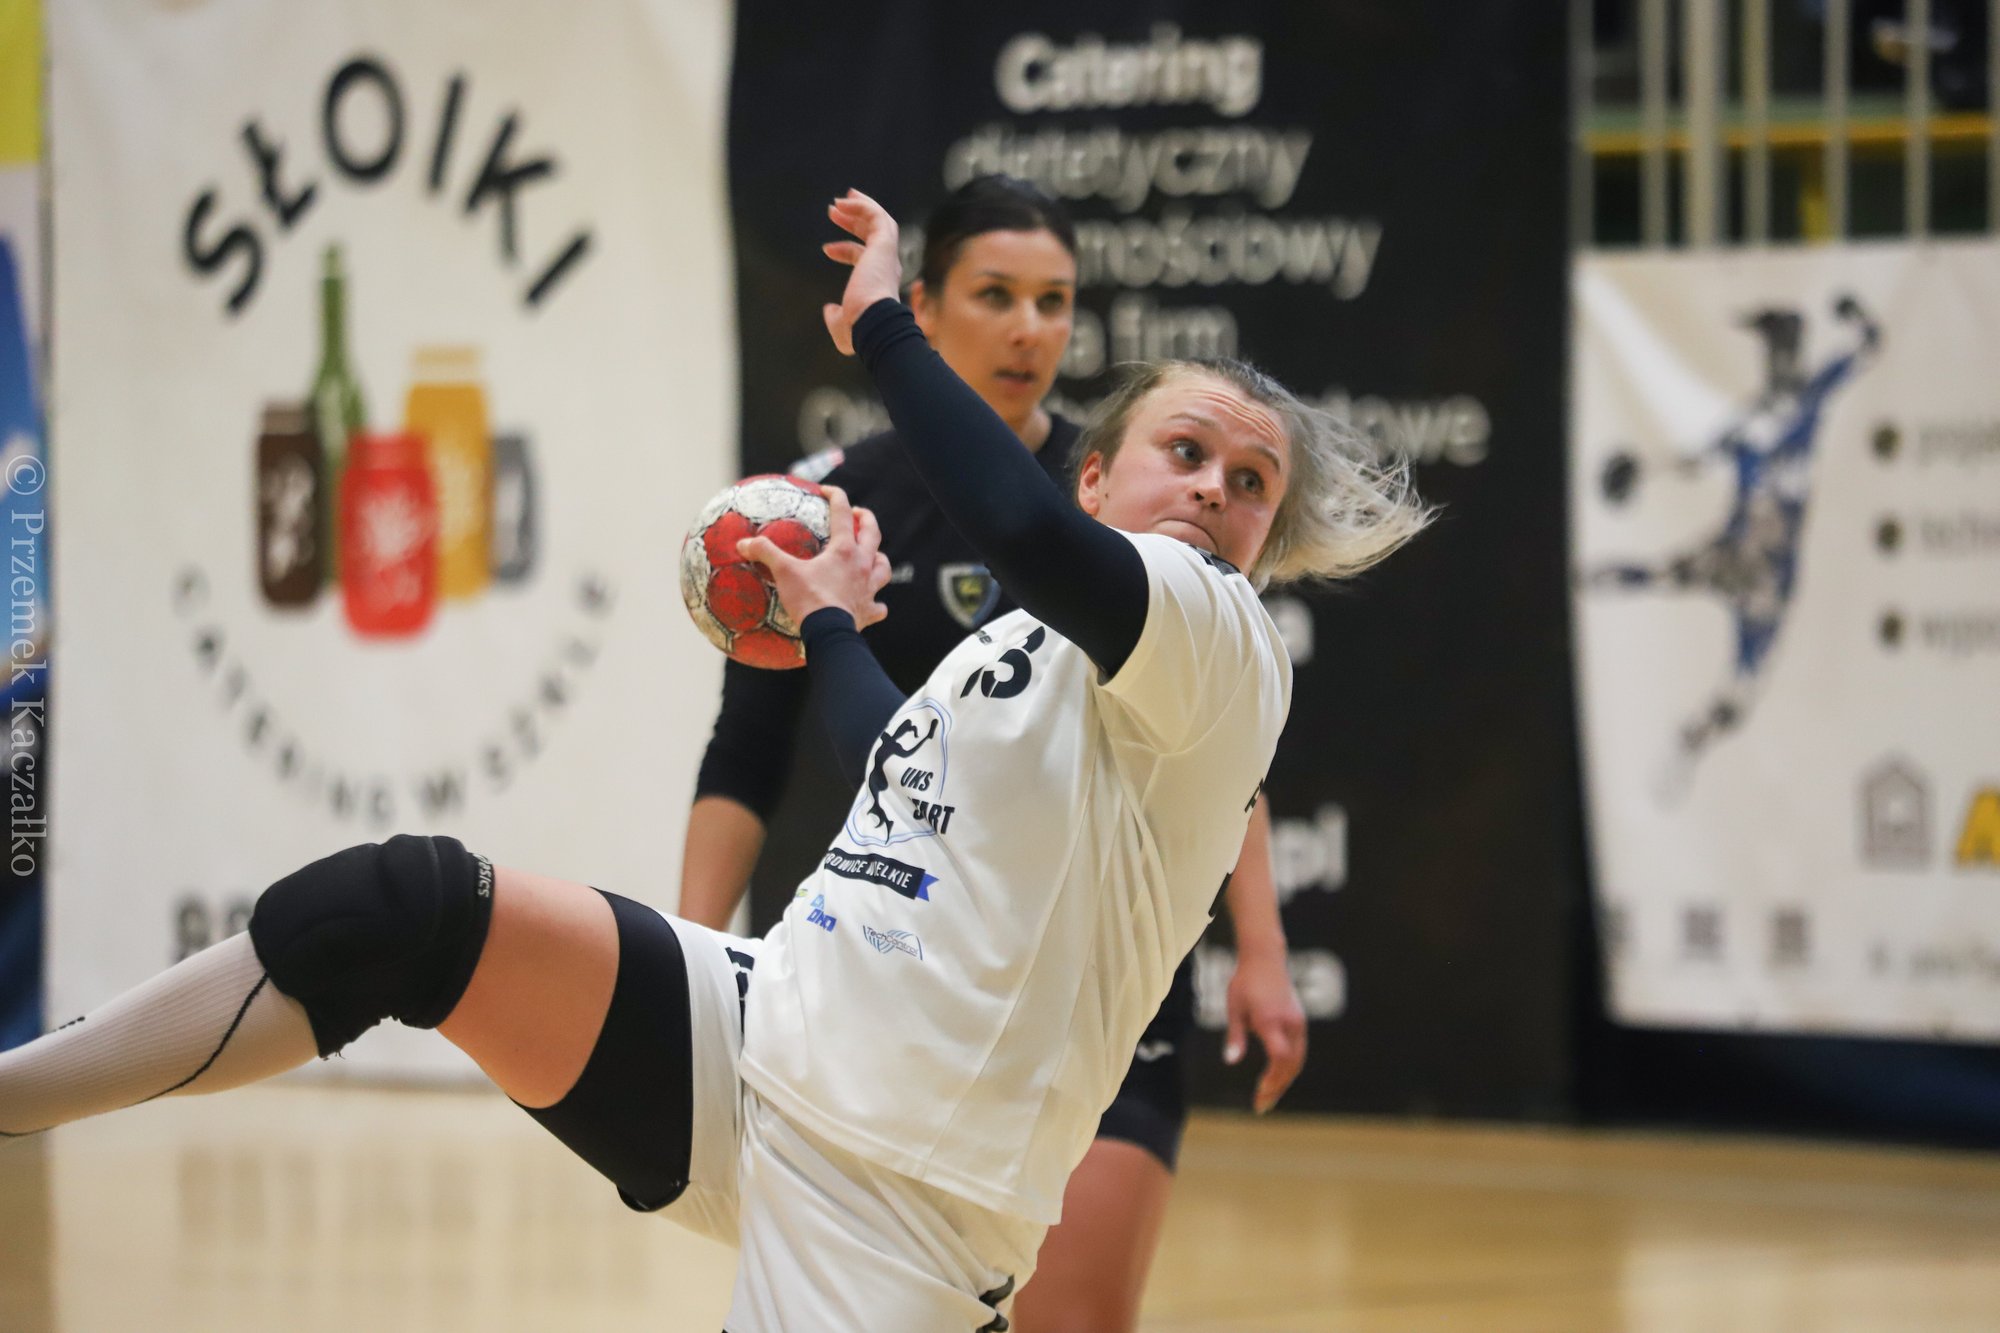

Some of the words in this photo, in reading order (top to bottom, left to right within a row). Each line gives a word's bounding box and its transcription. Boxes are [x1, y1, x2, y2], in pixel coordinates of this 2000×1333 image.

[997, 24, 1263, 118] Catering
[182, 55, 597, 314] SŁOIKI
[900, 766, 934, 792] UKS
